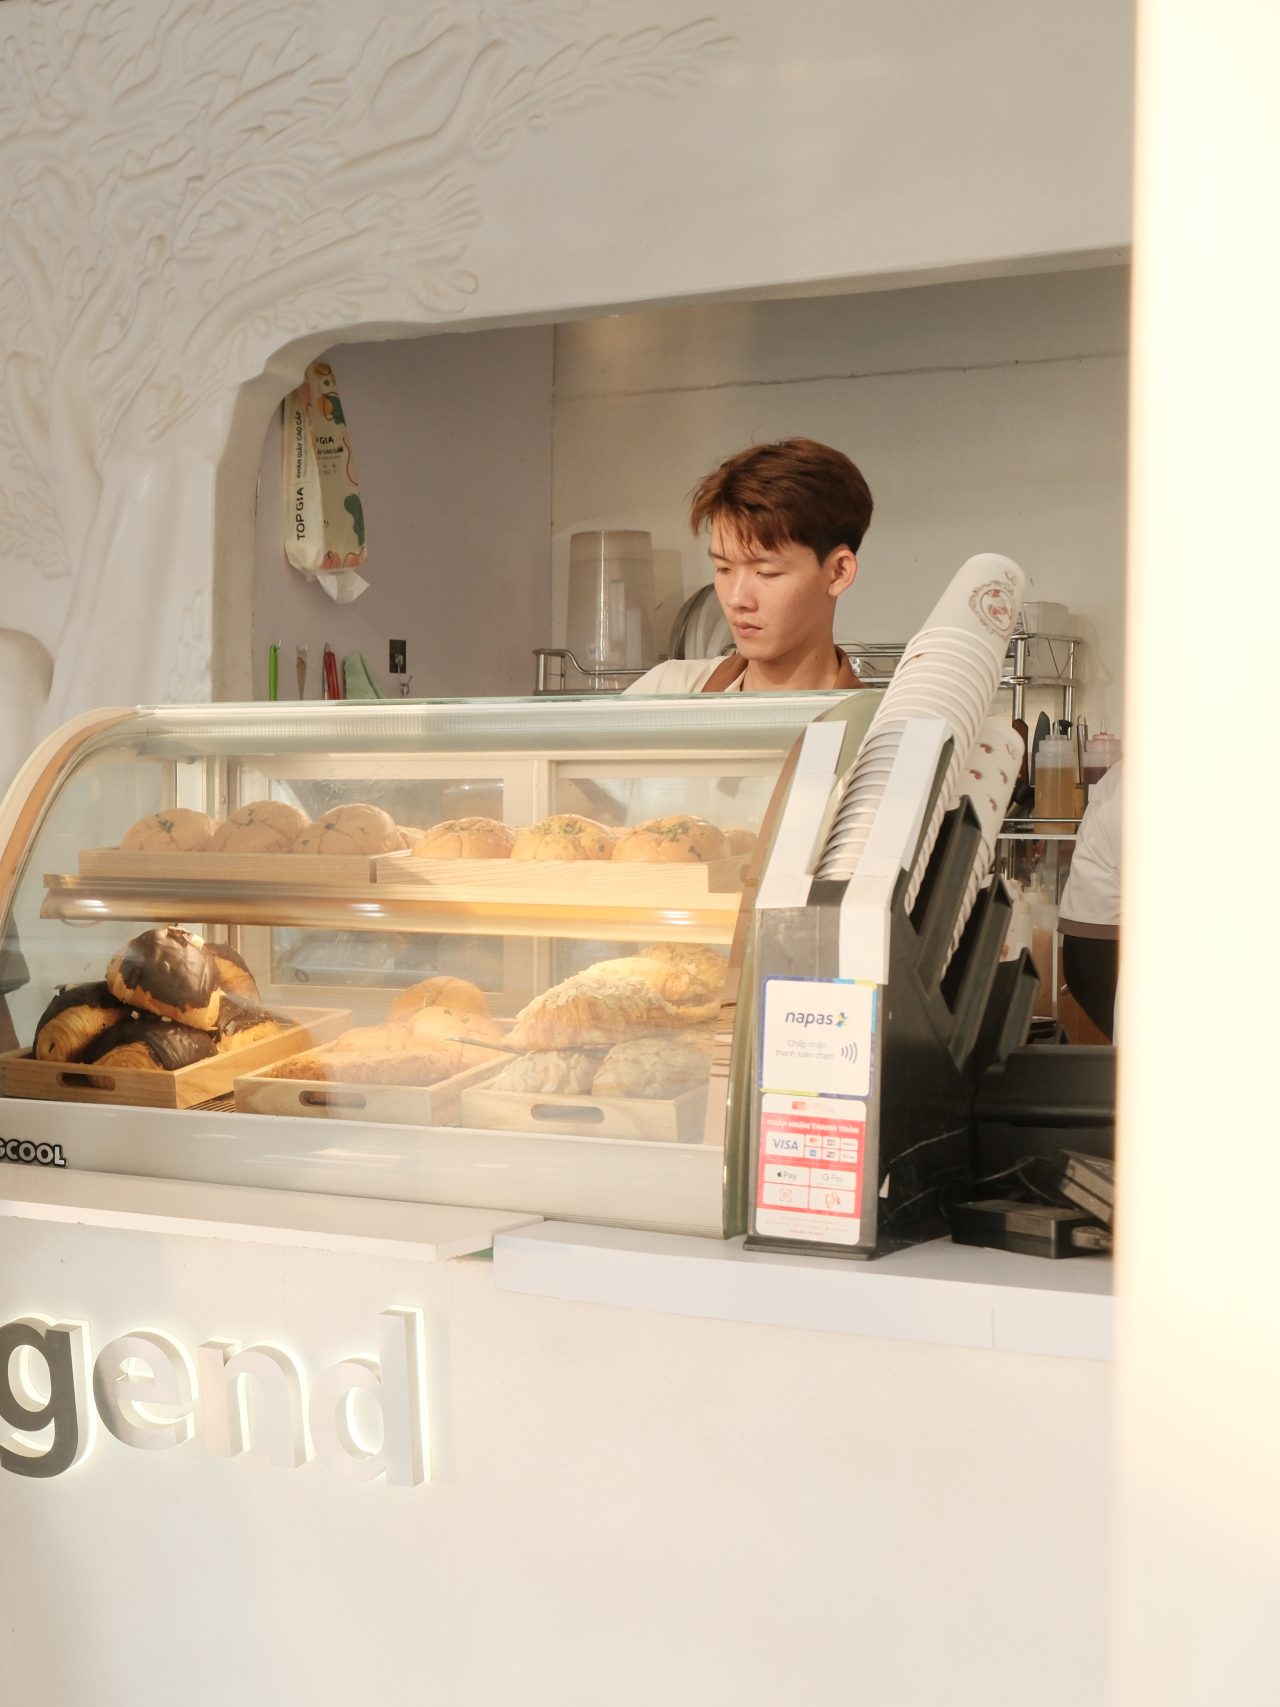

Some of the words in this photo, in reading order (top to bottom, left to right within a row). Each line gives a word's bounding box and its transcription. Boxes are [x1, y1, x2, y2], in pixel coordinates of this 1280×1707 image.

[296, 486, 304, 511] GIA
[295, 513, 306, 541] TOP
[785, 1011, 834, 1028] napas
[773, 1138, 799, 1150] VISA
[783, 1170, 798, 1181] Pay
